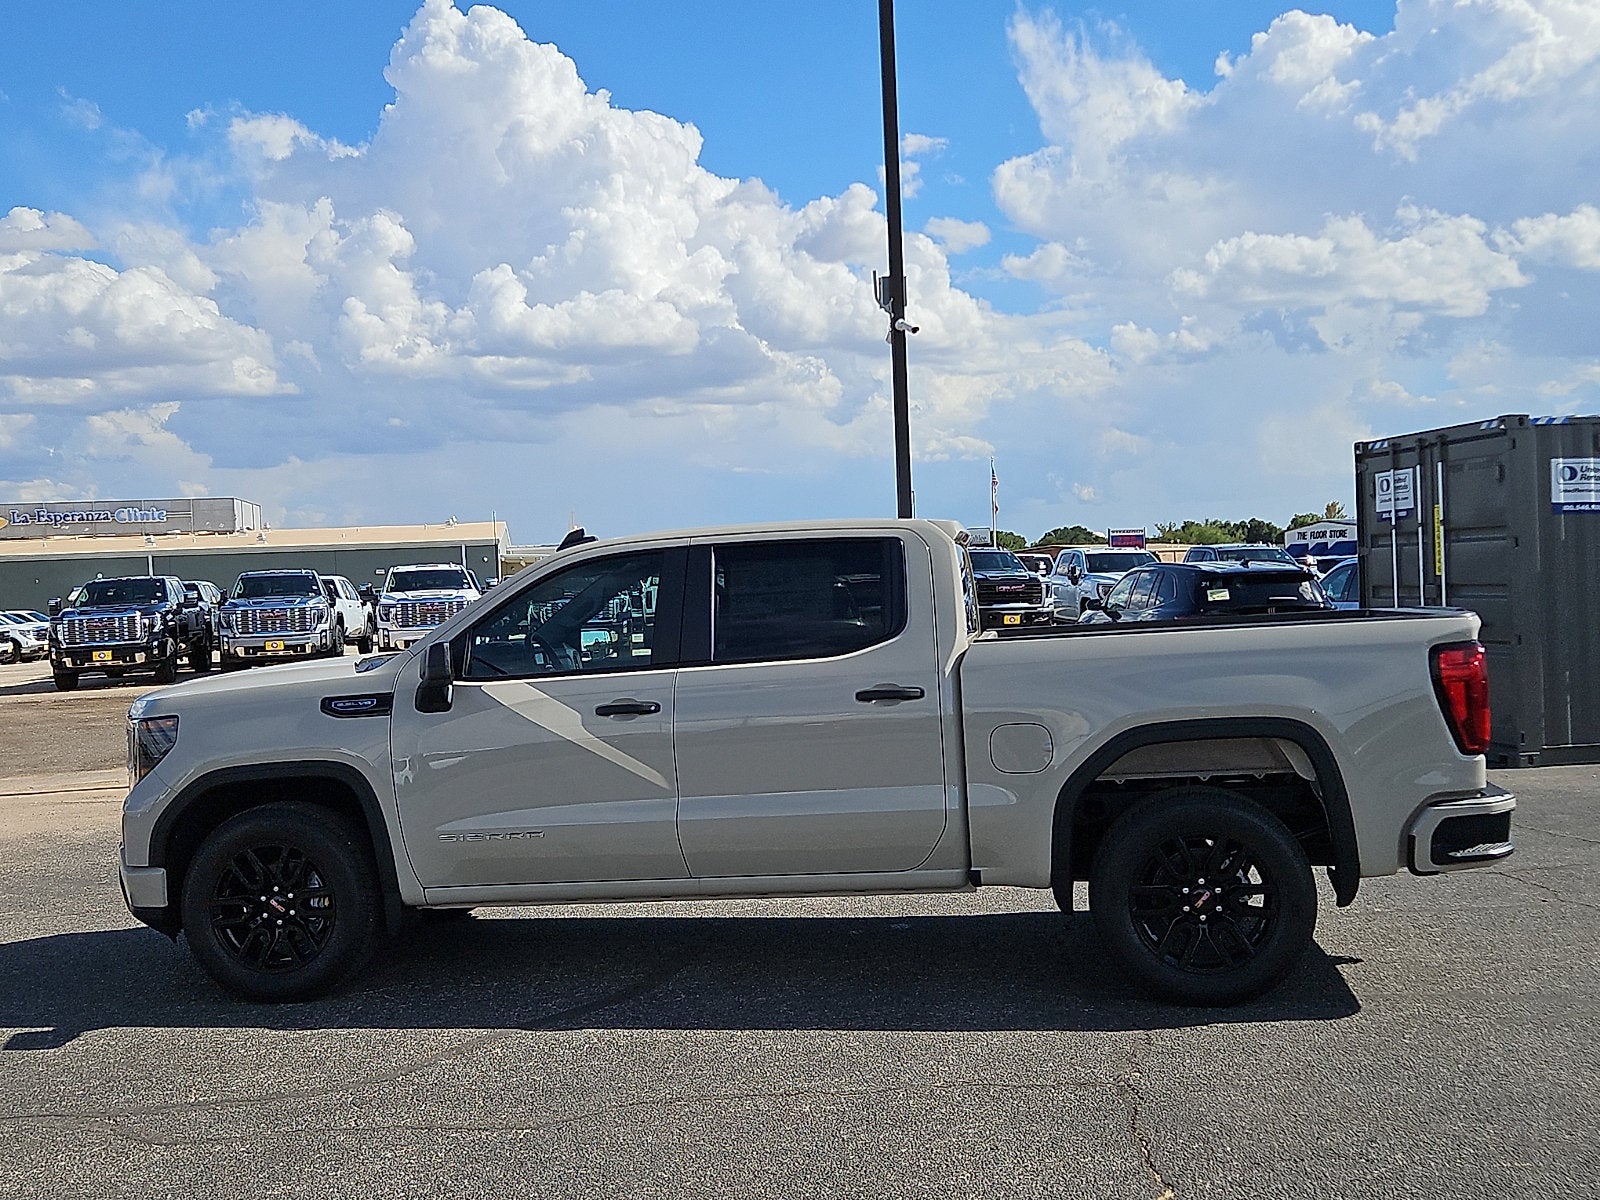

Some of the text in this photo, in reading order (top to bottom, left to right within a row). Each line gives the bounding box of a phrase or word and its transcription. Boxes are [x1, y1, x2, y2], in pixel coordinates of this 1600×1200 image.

[11, 507, 167, 527] La Esperanza Clinic
[1297, 529, 1348, 540] THE FLOOR STORE
[439, 831, 545, 842] SIERRA
